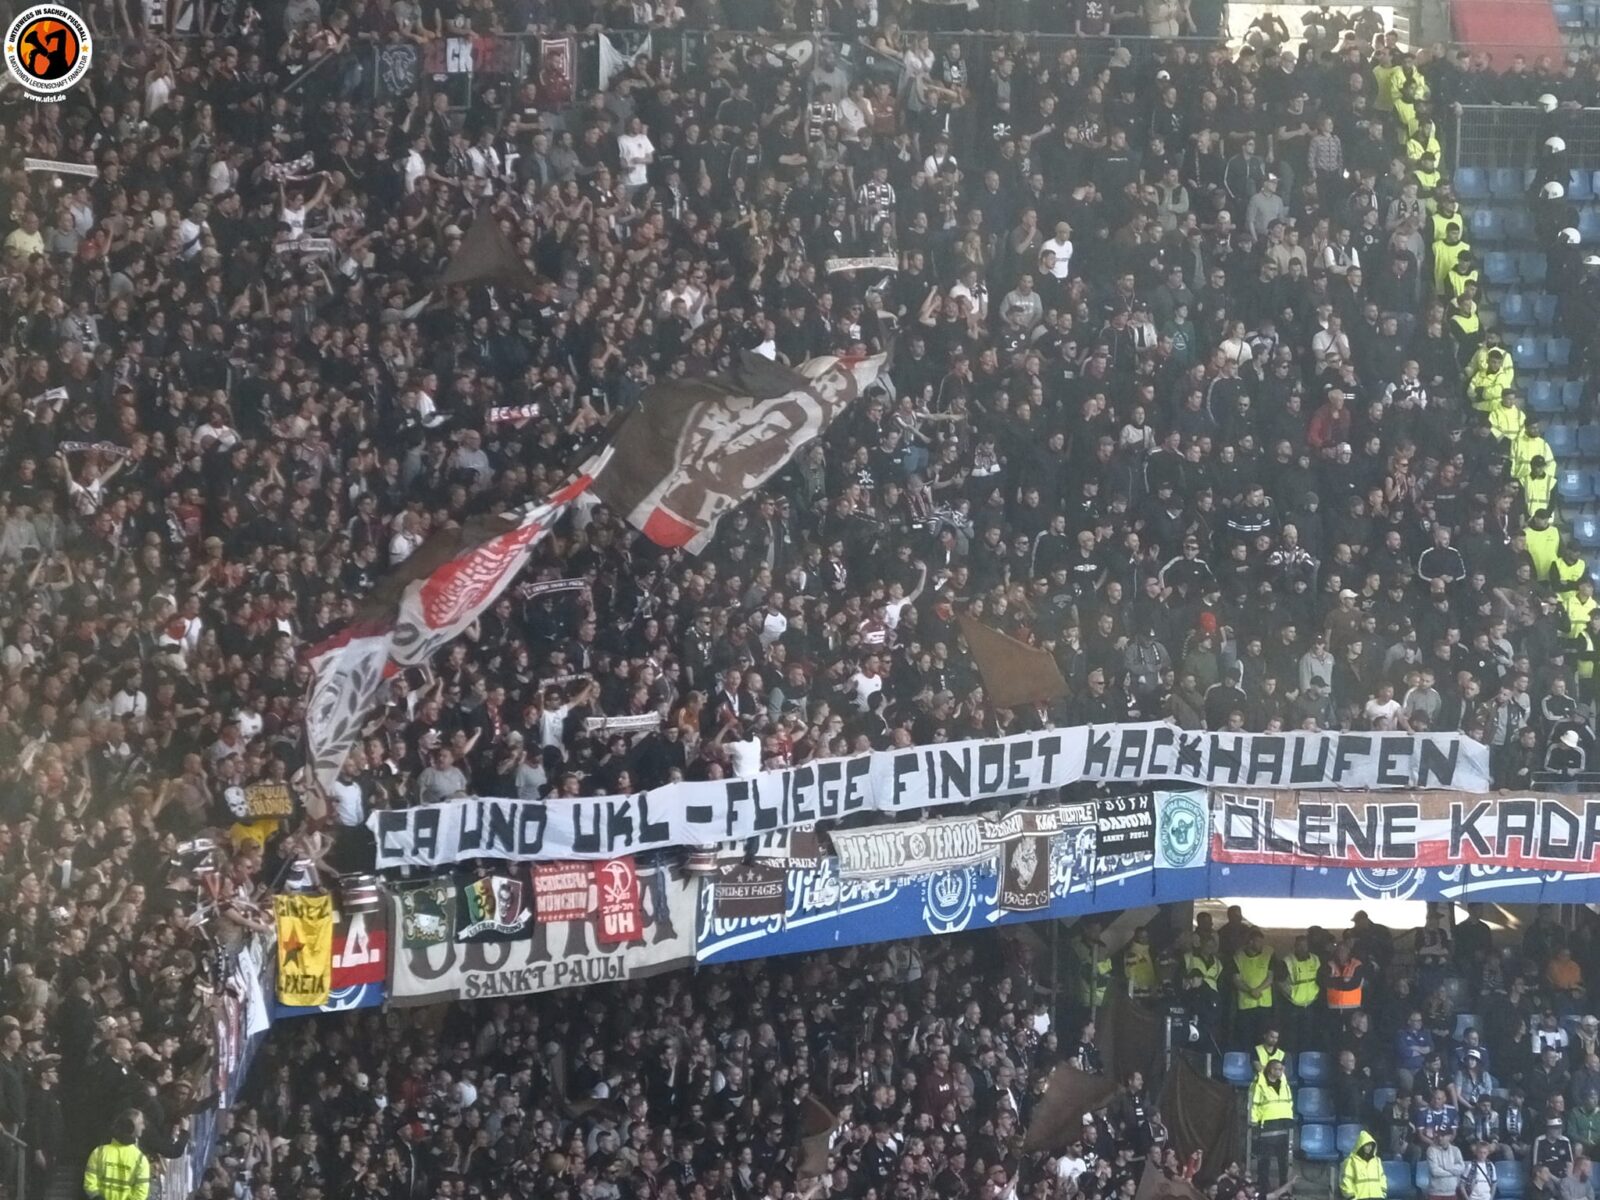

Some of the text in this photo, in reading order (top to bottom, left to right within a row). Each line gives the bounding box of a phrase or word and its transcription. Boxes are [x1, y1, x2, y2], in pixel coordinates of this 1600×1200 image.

[457, 802, 548, 855] UND
[571, 793, 670, 853] UKL
[726, 754, 870, 837] FLIEGE
[892, 736, 1061, 806] FINDET
[1082, 726, 1460, 786] KACKHAUFEN
[1099, 812, 1152, 831] DARUM
[837, 832, 906, 872] ENFANTS
[715, 884, 783, 897] SMILEY FACES
[604, 911, 635, 936] UH
[464, 956, 627, 999] SANKT PAULI
